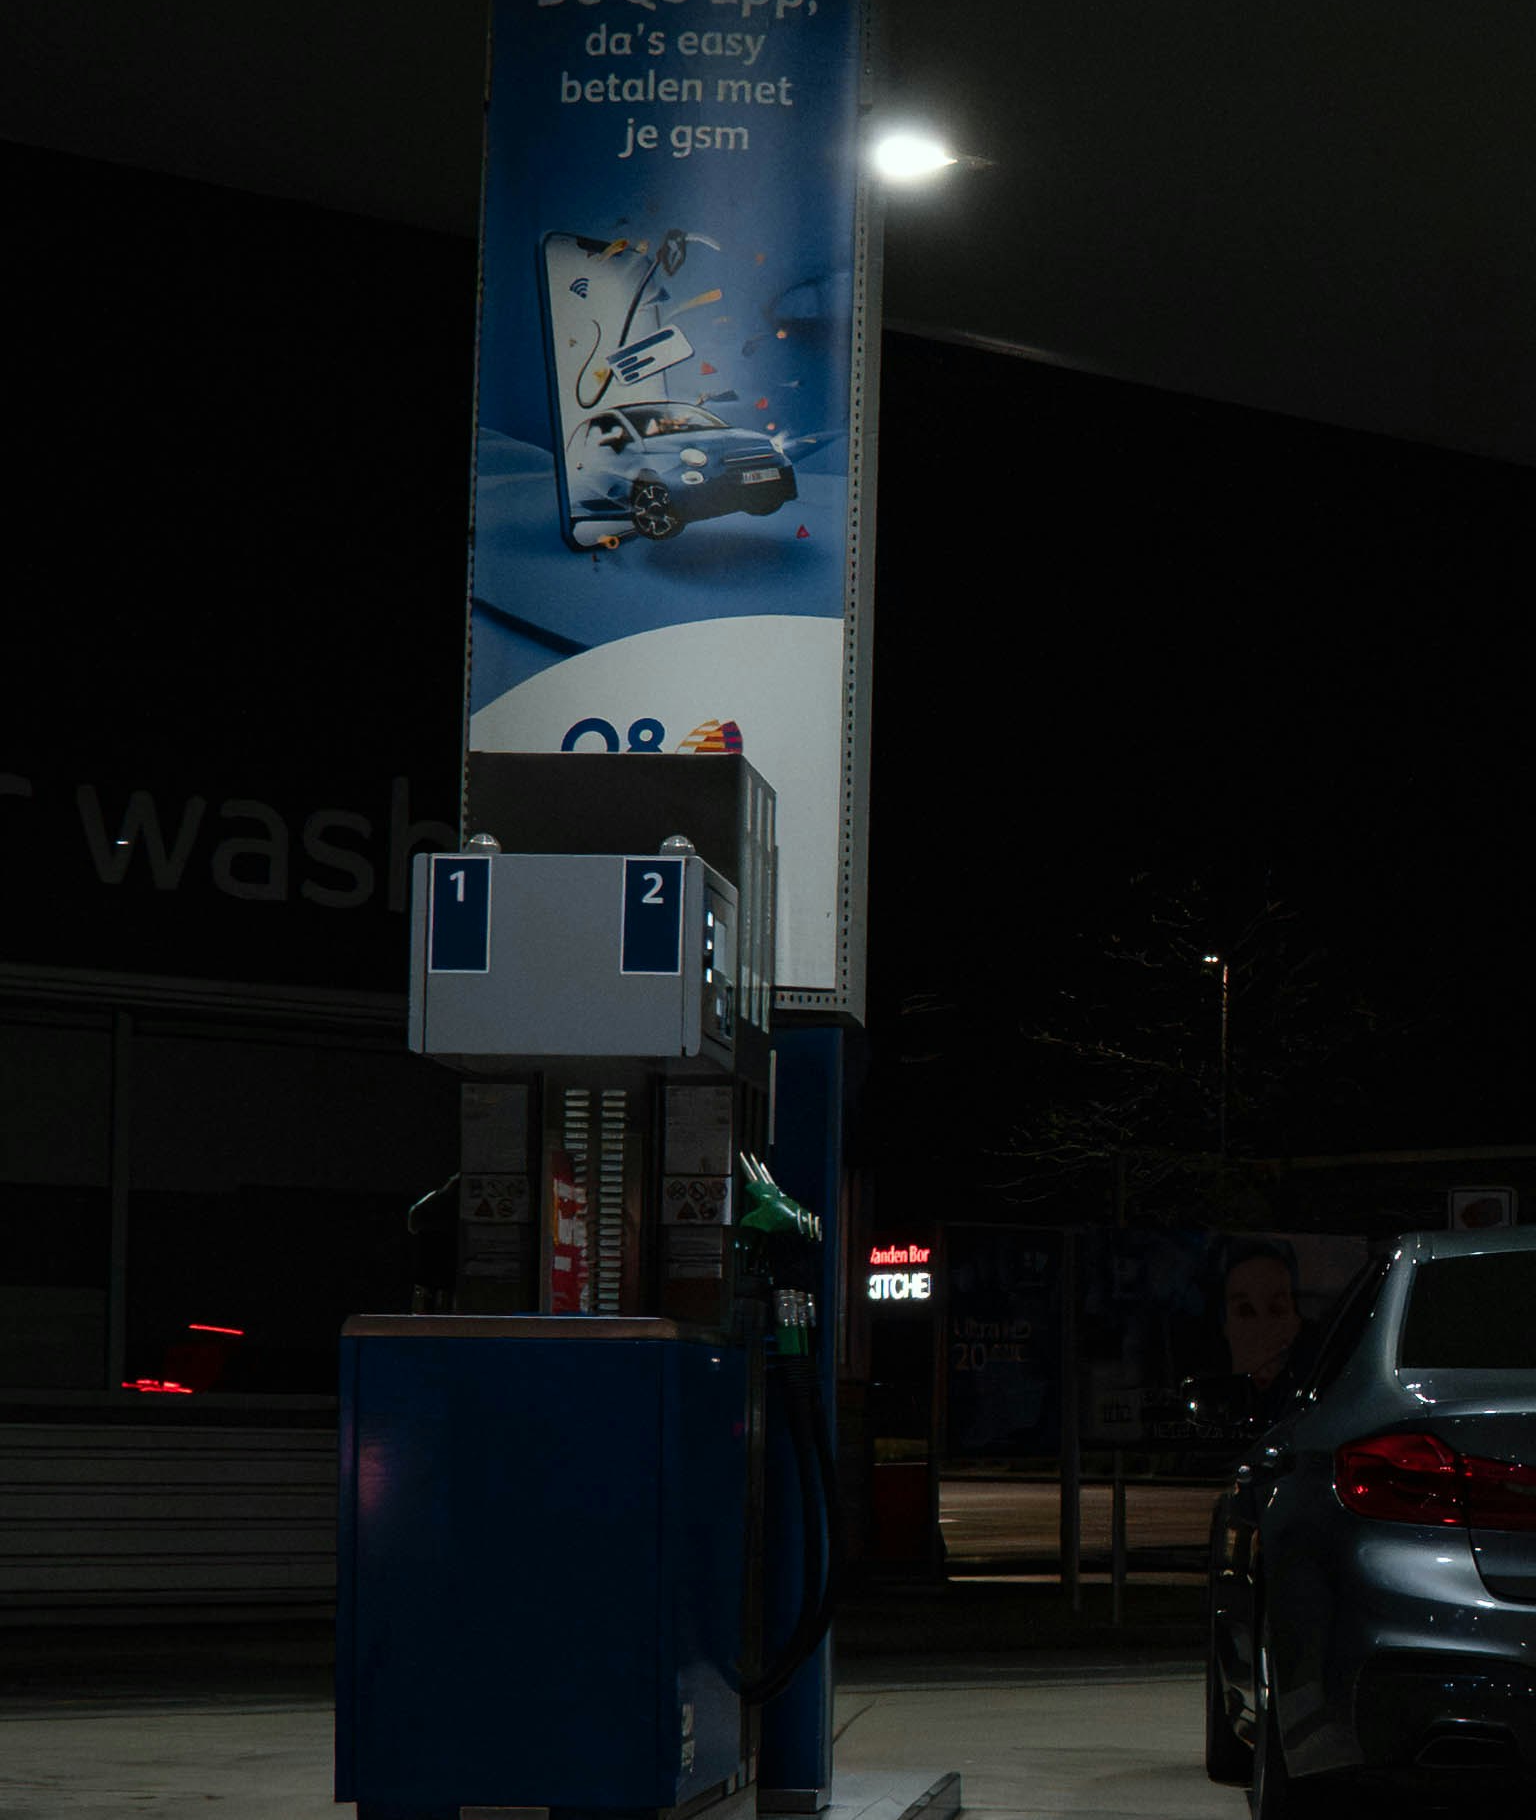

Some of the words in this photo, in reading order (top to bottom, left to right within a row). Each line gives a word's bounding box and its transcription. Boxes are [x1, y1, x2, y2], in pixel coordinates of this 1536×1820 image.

[585, 23, 665, 56] da's
[677, 30, 766, 65] easy
[561, 69, 702, 103] betalen
[717, 77, 793, 105] met
[618, 118, 658, 158] je
[670, 122, 749, 157] gsm
[448, 870, 467, 903] 1
[642, 872, 665, 904] 2
